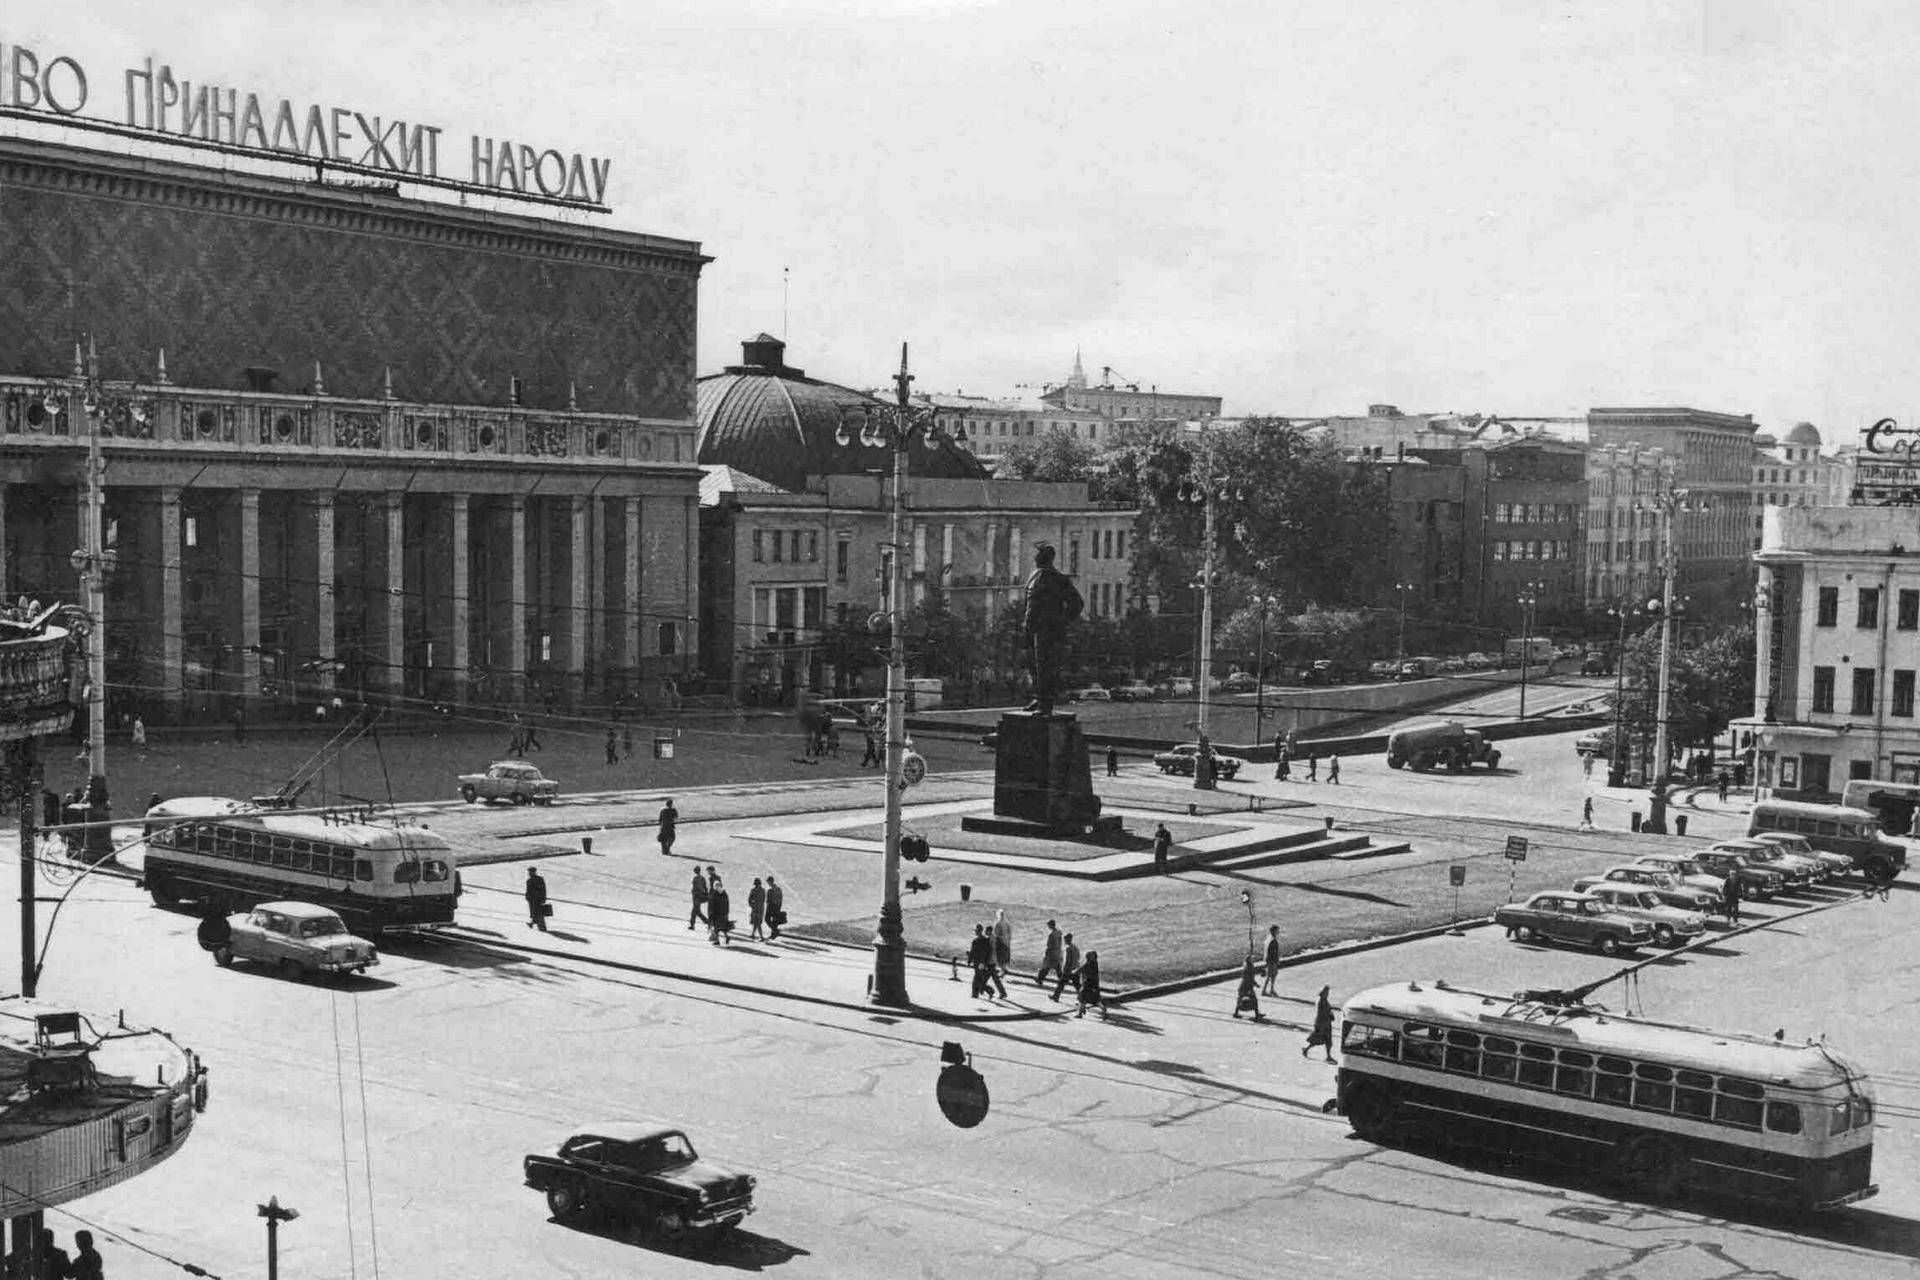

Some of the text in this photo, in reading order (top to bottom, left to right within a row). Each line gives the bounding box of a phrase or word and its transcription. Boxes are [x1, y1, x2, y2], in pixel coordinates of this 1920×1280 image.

[0, 43, 611, 204] ВО ПРИНАДЛЕЖИТ НАРОДУ
